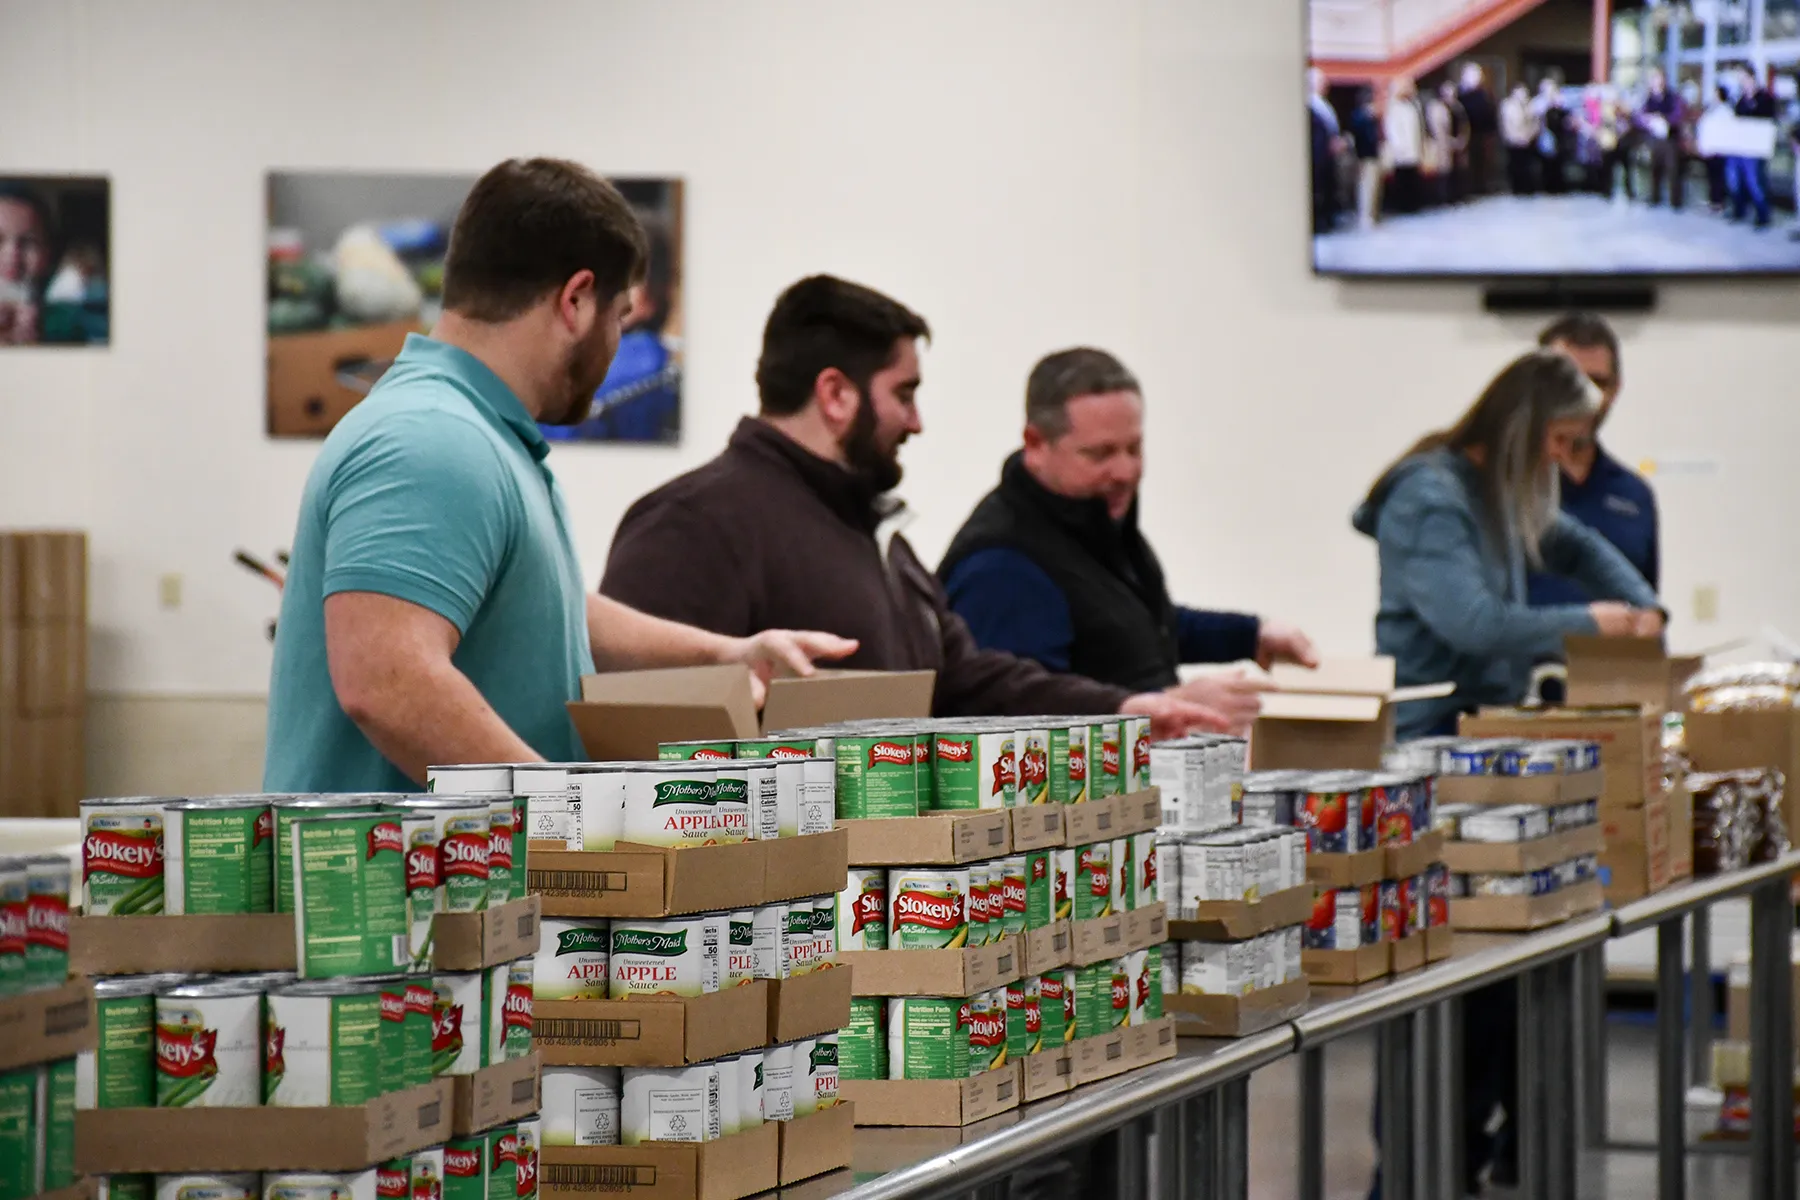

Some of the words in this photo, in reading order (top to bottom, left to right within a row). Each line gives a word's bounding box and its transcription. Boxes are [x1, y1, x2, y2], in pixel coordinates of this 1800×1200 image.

[682, 830, 708, 838] Sauce
[87, 836, 165, 867] Stokely's
[898, 895, 961, 921] Stokely's
[647, 936, 682, 951] Maid
[616, 967, 677, 981] APPLE
[628, 980, 658, 989] Sauce
